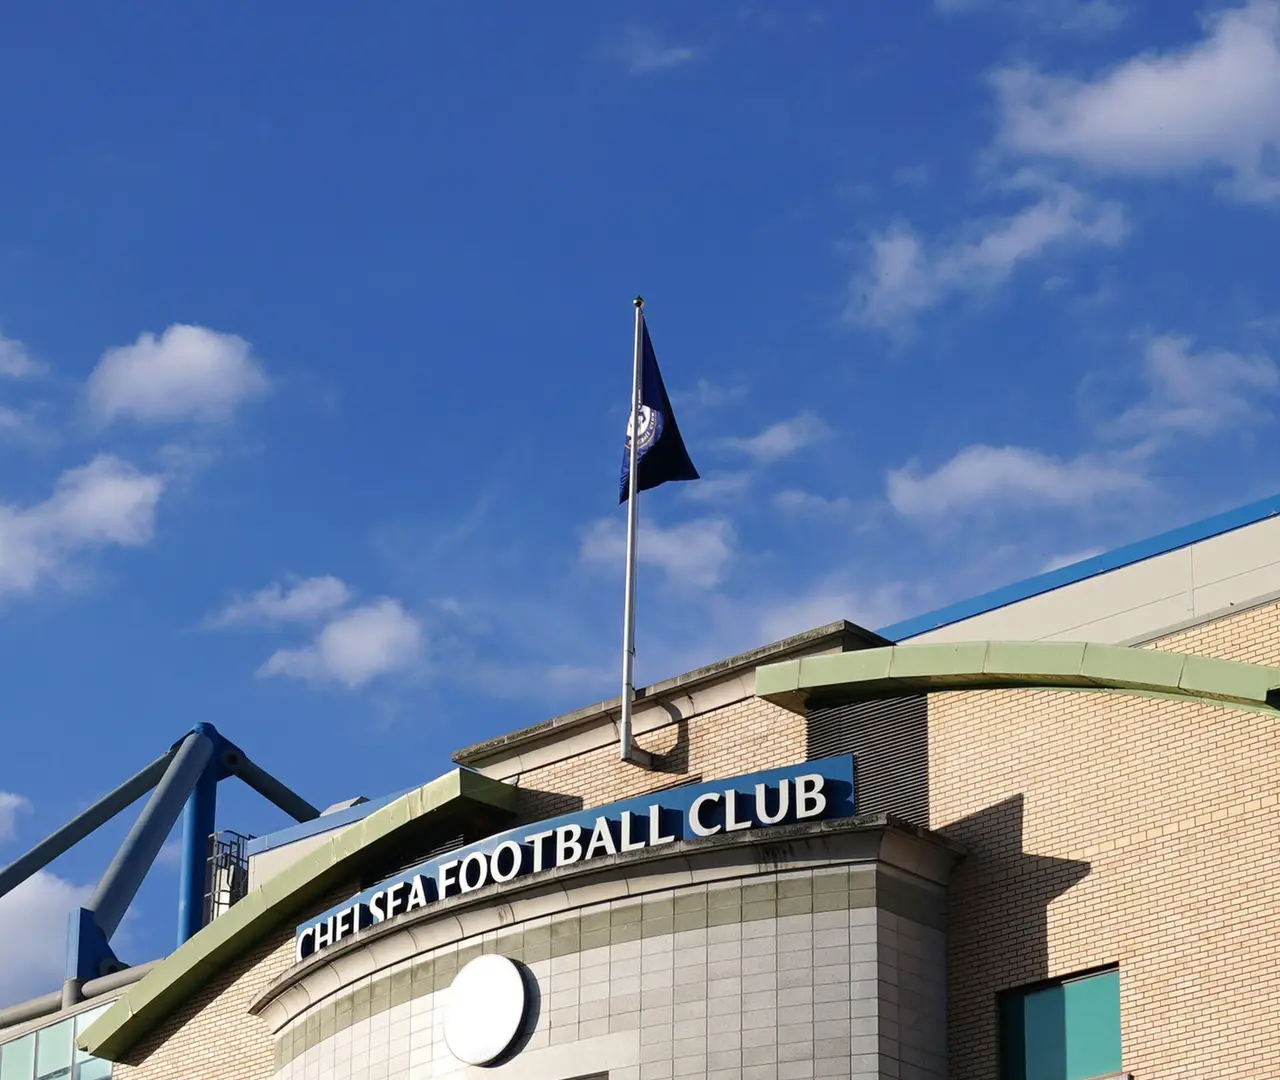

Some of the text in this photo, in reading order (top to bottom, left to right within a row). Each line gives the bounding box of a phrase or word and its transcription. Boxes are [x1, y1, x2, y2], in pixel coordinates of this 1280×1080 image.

[296, 773, 827, 964] CHELSEA FOOTBALL CLUB
